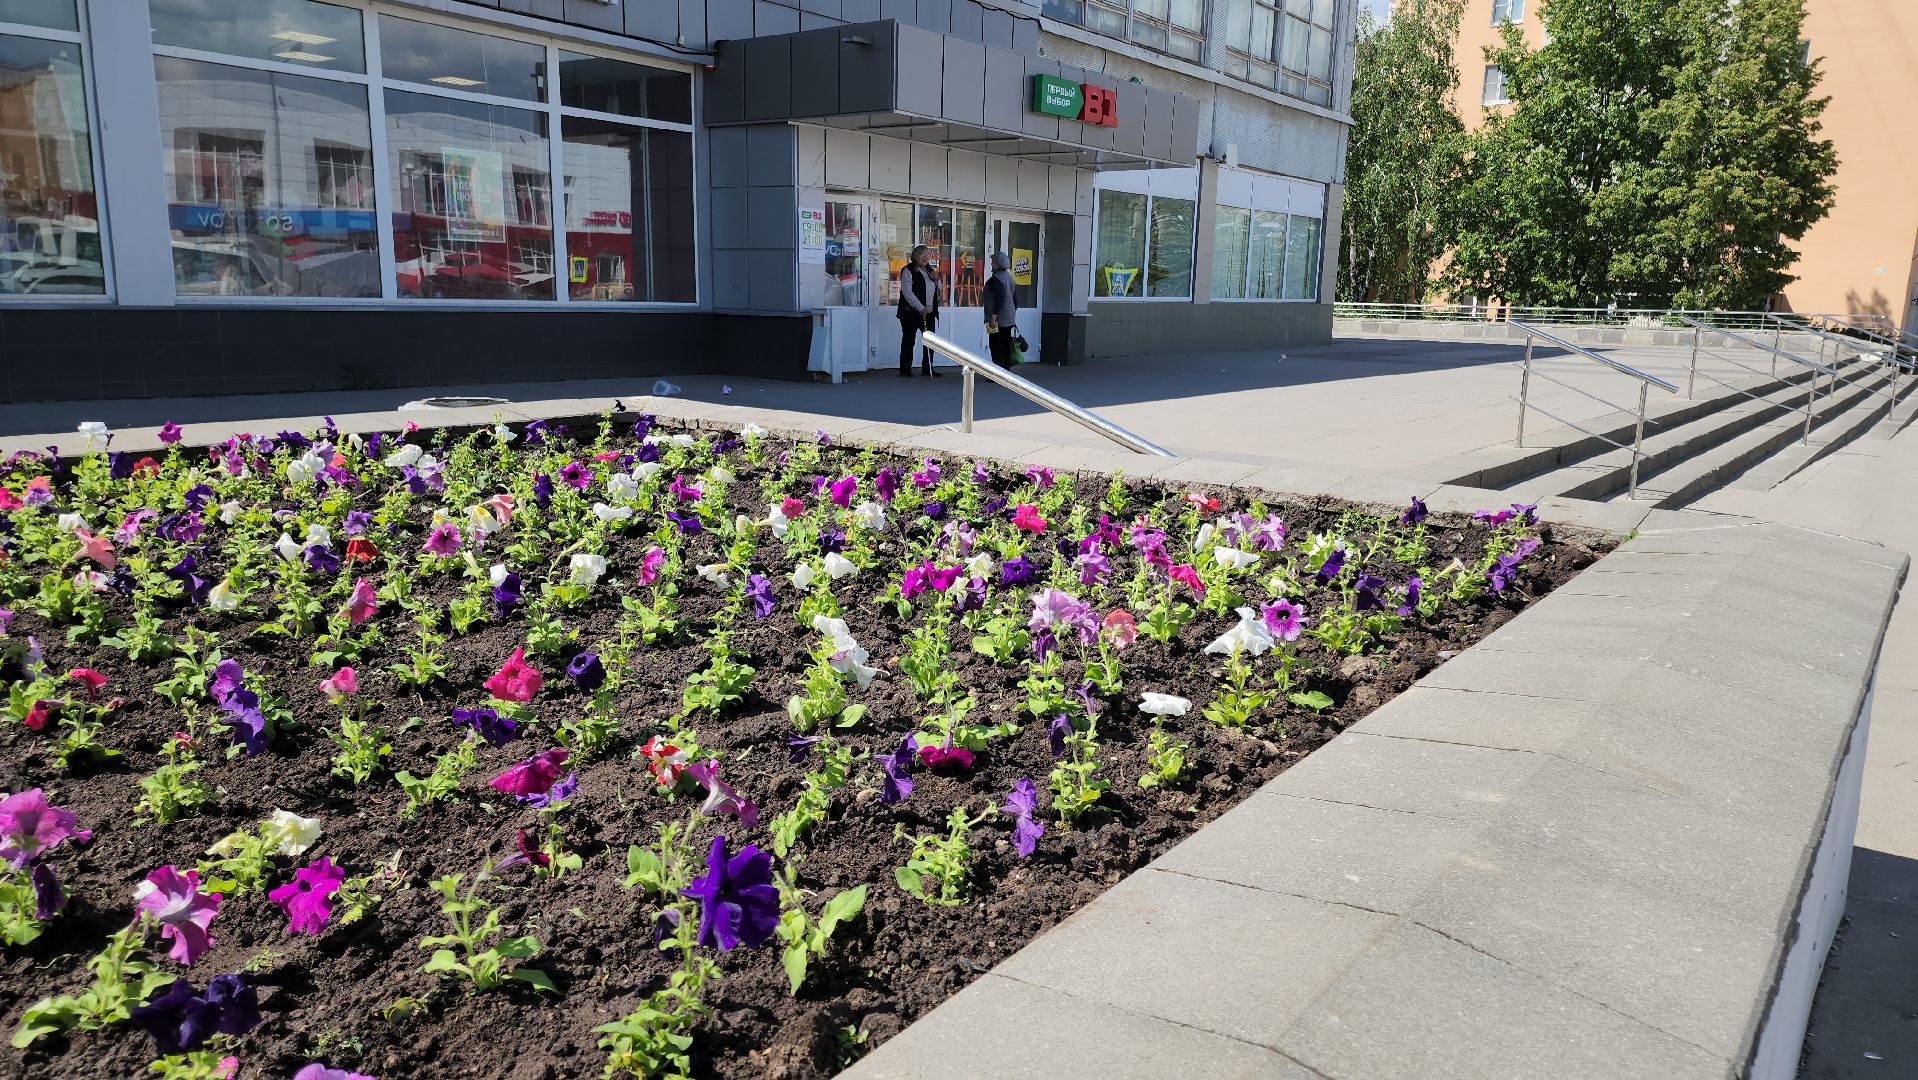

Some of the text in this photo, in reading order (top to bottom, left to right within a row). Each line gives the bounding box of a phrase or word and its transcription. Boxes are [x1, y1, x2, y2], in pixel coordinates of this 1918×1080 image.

[1047, 83, 1075, 99] ПЕРВЫЙ
[1046, 95, 1071, 108] ВЫБОР
[1083, 83, 1119, 129] В1
